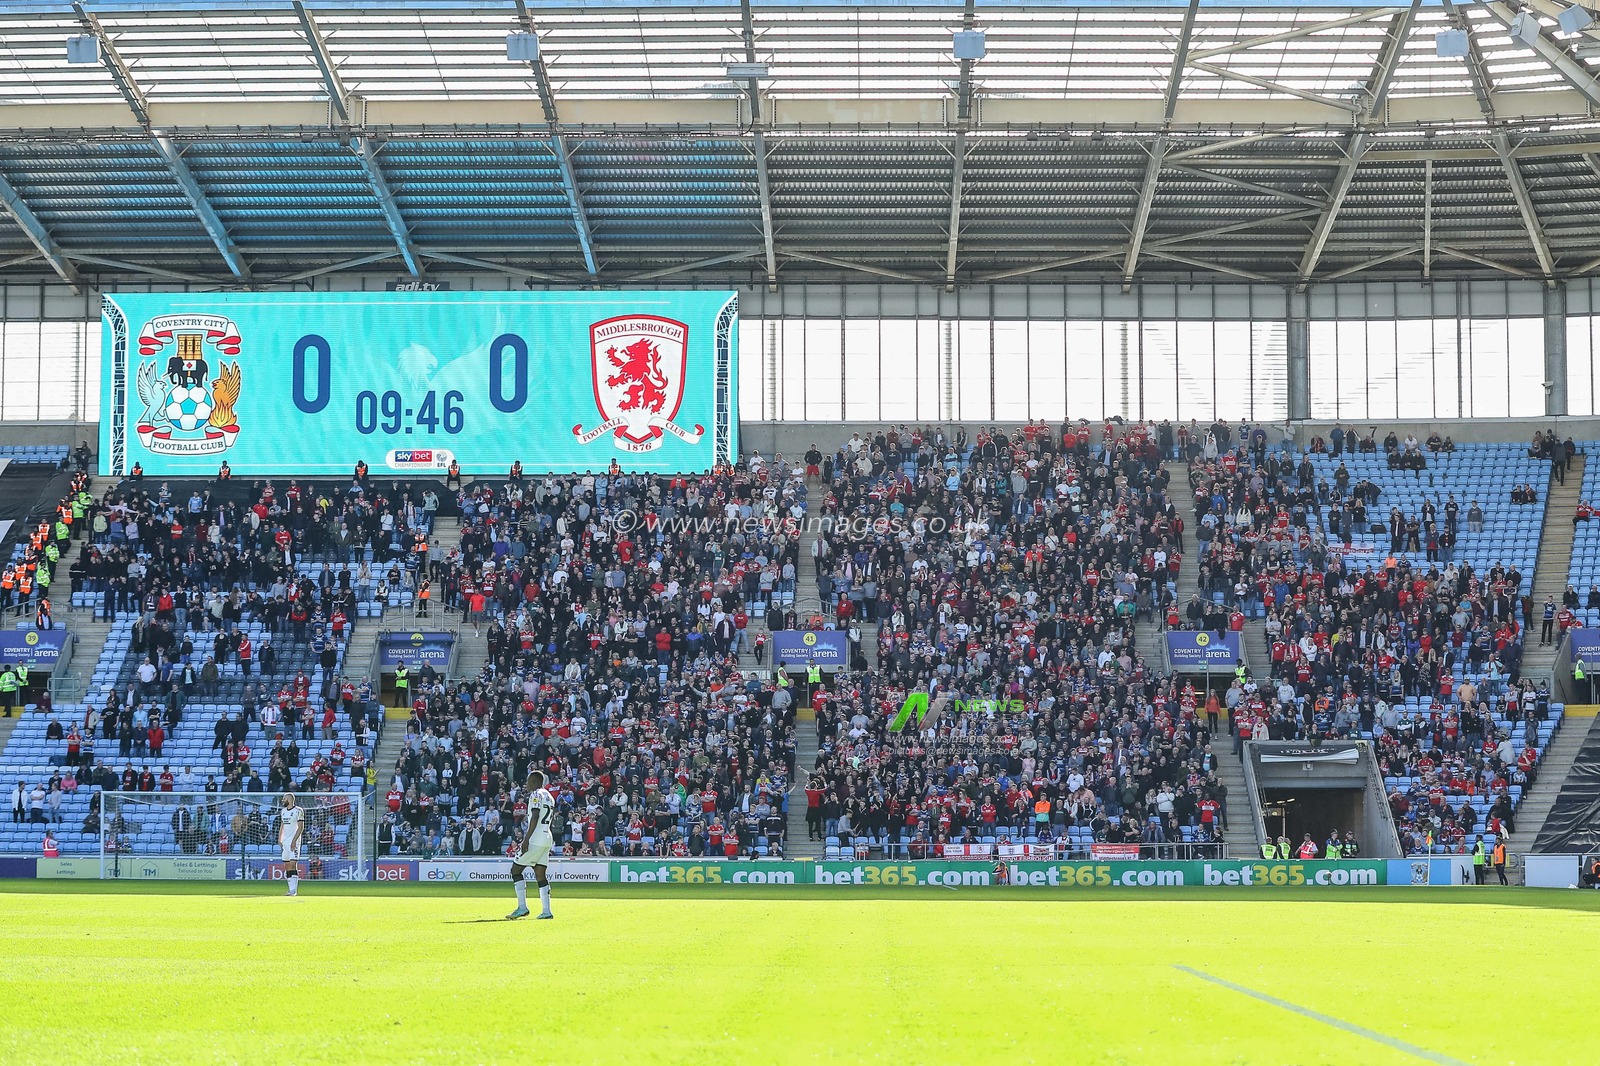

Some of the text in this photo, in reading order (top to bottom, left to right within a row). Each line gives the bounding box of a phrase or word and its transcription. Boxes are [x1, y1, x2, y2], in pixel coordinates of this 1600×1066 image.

[395, 281, 440, 291] adi.tv
[155, 319, 226, 328] COVENTRY CITY
[596, 322, 682, 338] MIDDLESBROUGH
[292, 334, 331, 414] 0
[489, 333, 528, 413] 0
[355, 390, 464, 434] 09:46
[582, 418, 686, 442] FOOTBALL CLUB
[152, 441, 224, 450] FOOTBALL CLUB
[626, 443, 652, 451] 1876
[396, 451, 430, 461] sky bet
[376, 866, 406, 881] bet
[427, 867, 462, 881] ebay
[469, 872, 514, 880] Championi
[563, 872, 600, 881] Coventry
[620, 864, 795, 883] bet365.com
[814, 865, 990, 886] bet365.com
[1009, 864, 1184, 886] bet365.com
[1203, 863, 1377, 886] bet365.com
